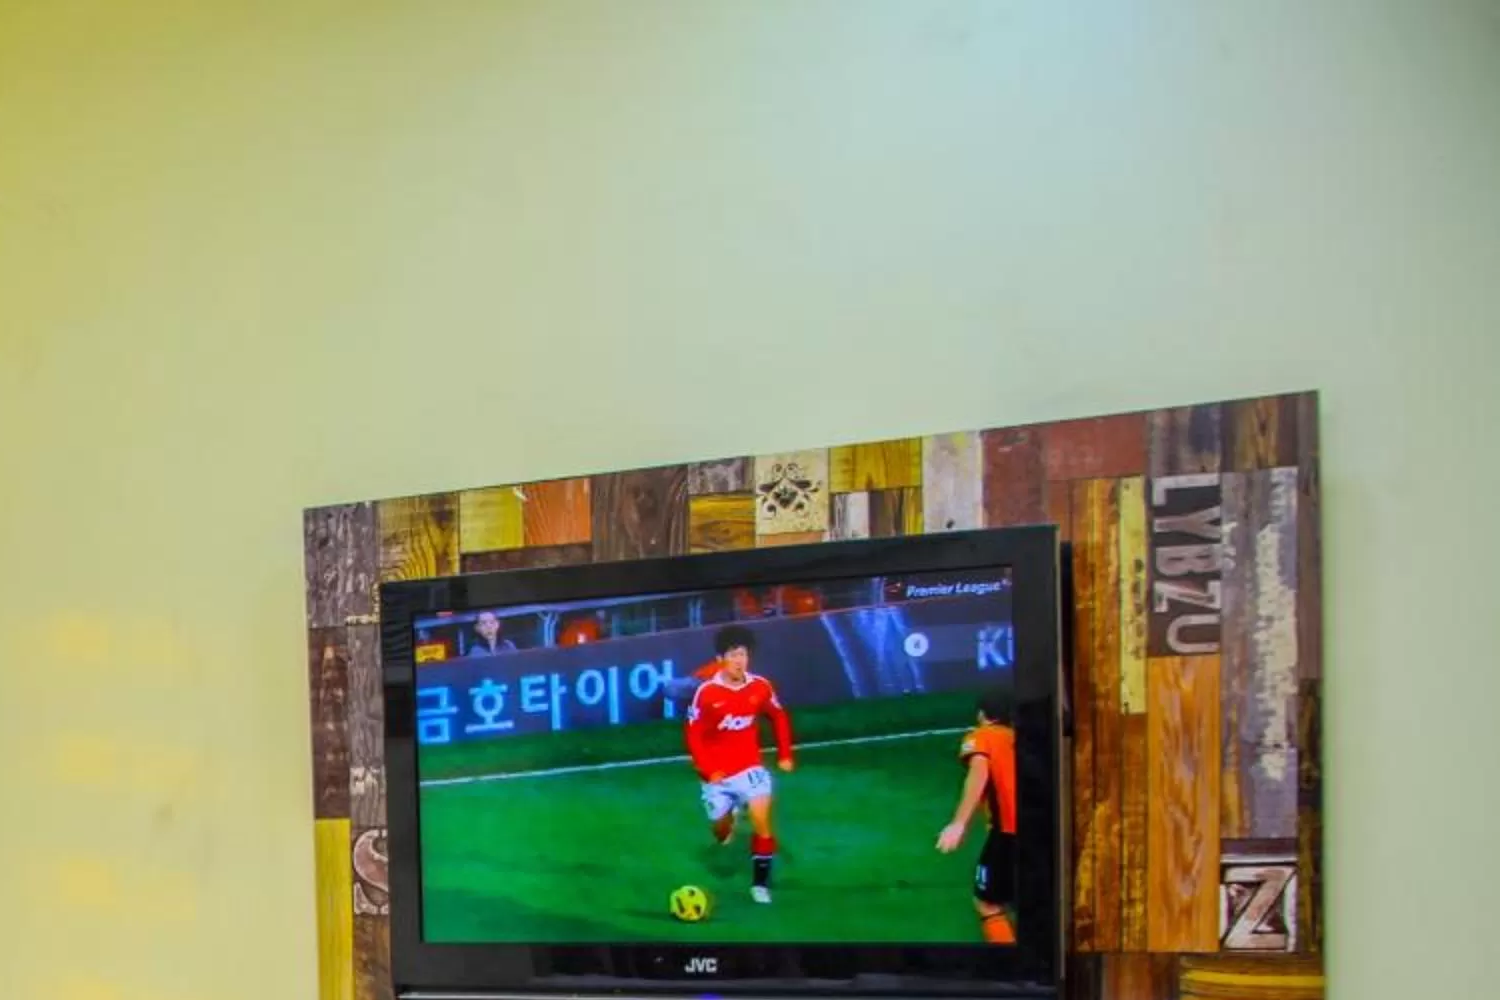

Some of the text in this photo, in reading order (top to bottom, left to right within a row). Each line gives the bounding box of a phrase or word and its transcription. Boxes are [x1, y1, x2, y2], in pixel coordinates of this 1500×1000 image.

[906, 581, 1001, 597] Premier League
[416, 660, 675, 744] 금호타이어
[684, 957, 718, 973] JVC
